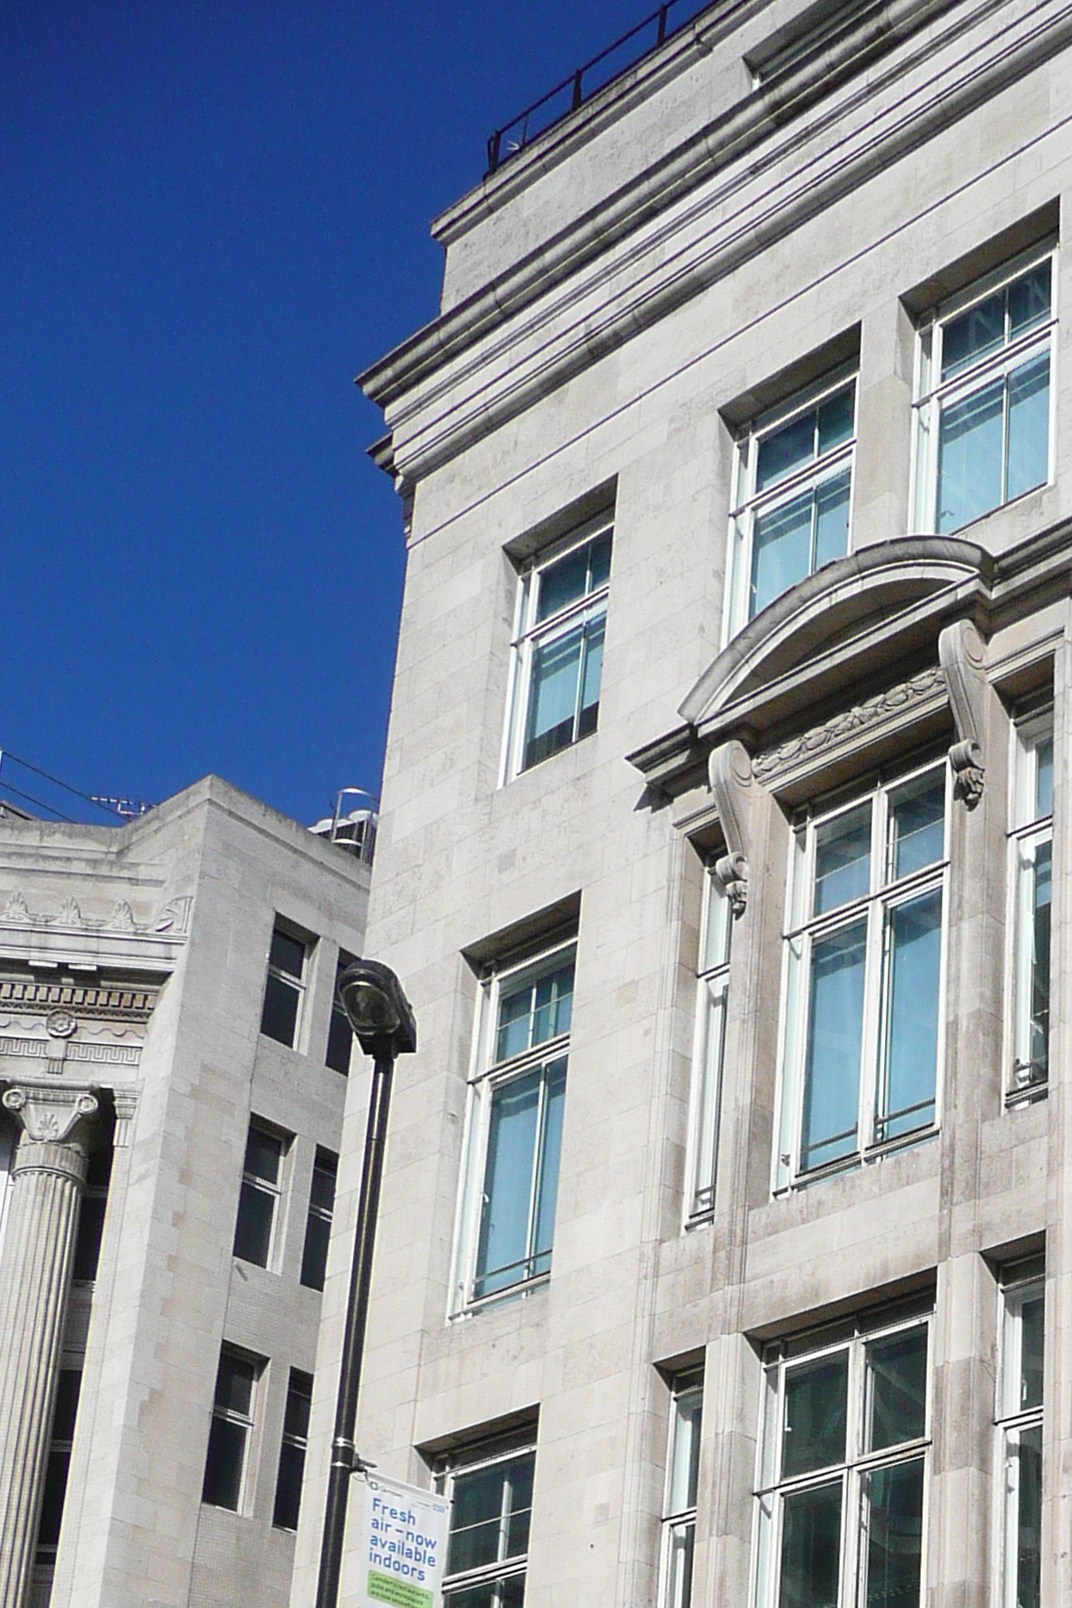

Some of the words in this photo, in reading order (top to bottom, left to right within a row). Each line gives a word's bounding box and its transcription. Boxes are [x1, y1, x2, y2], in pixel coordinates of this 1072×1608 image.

[372, 1497, 416, 1526] Fresh
[371, 1517, 392, 1533] air
[405, 1531, 437, 1550] now
[368, 1547, 426, 1582] indoors
[370, 1535, 437, 1567] available
